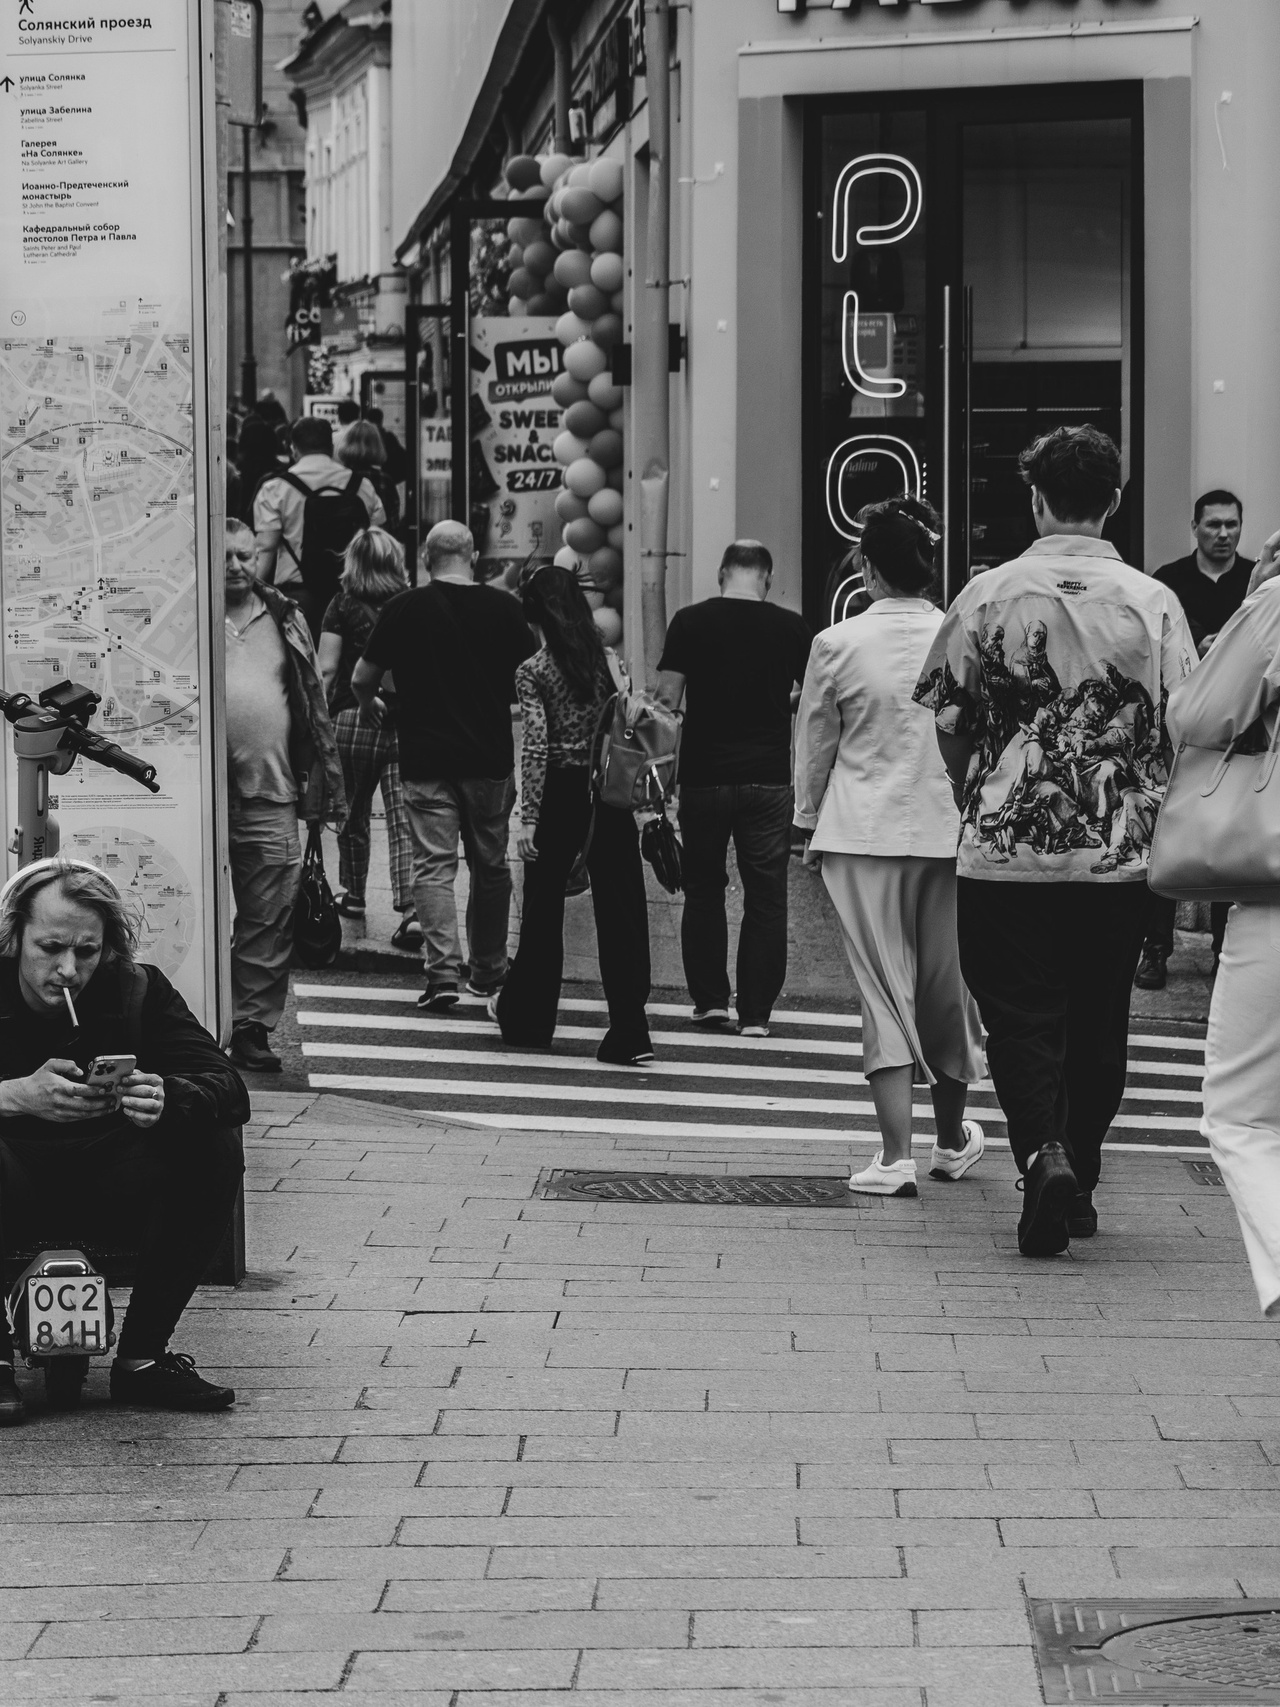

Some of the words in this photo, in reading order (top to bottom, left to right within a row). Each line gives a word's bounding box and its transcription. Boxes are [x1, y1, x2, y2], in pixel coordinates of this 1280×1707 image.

[18, 17, 95, 31] Солянский
[100, 18, 152, 31] проезд
[19, 35, 66, 46] Solyanskiy
[68, 35, 93, 44] Drive
[20, 75, 46, 84] улица
[48, 73, 86, 82] Солянка
[20, 108, 47, 117] улица
[49, 106, 92, 114] Забелина
[21, 140, 57, 149] Галерея
[67, 158, 88, 166] Gallery
[22, 180, 129, 191] Иоанно-Предтеченский
[22, 192, 72, 201] монастырь
[22, 224, 91, 234] Кафедральный
[93, 223, 120, 232] собор
[23, 234, 69, 243] апостолов
[71, 233, 99, 243] Петра
[108, 232, 137, 241] Павла
[506, 347, 559, 377] МЫ
[528, 429, 539, 444] &
[514, 470, 556, 489] 24/7
